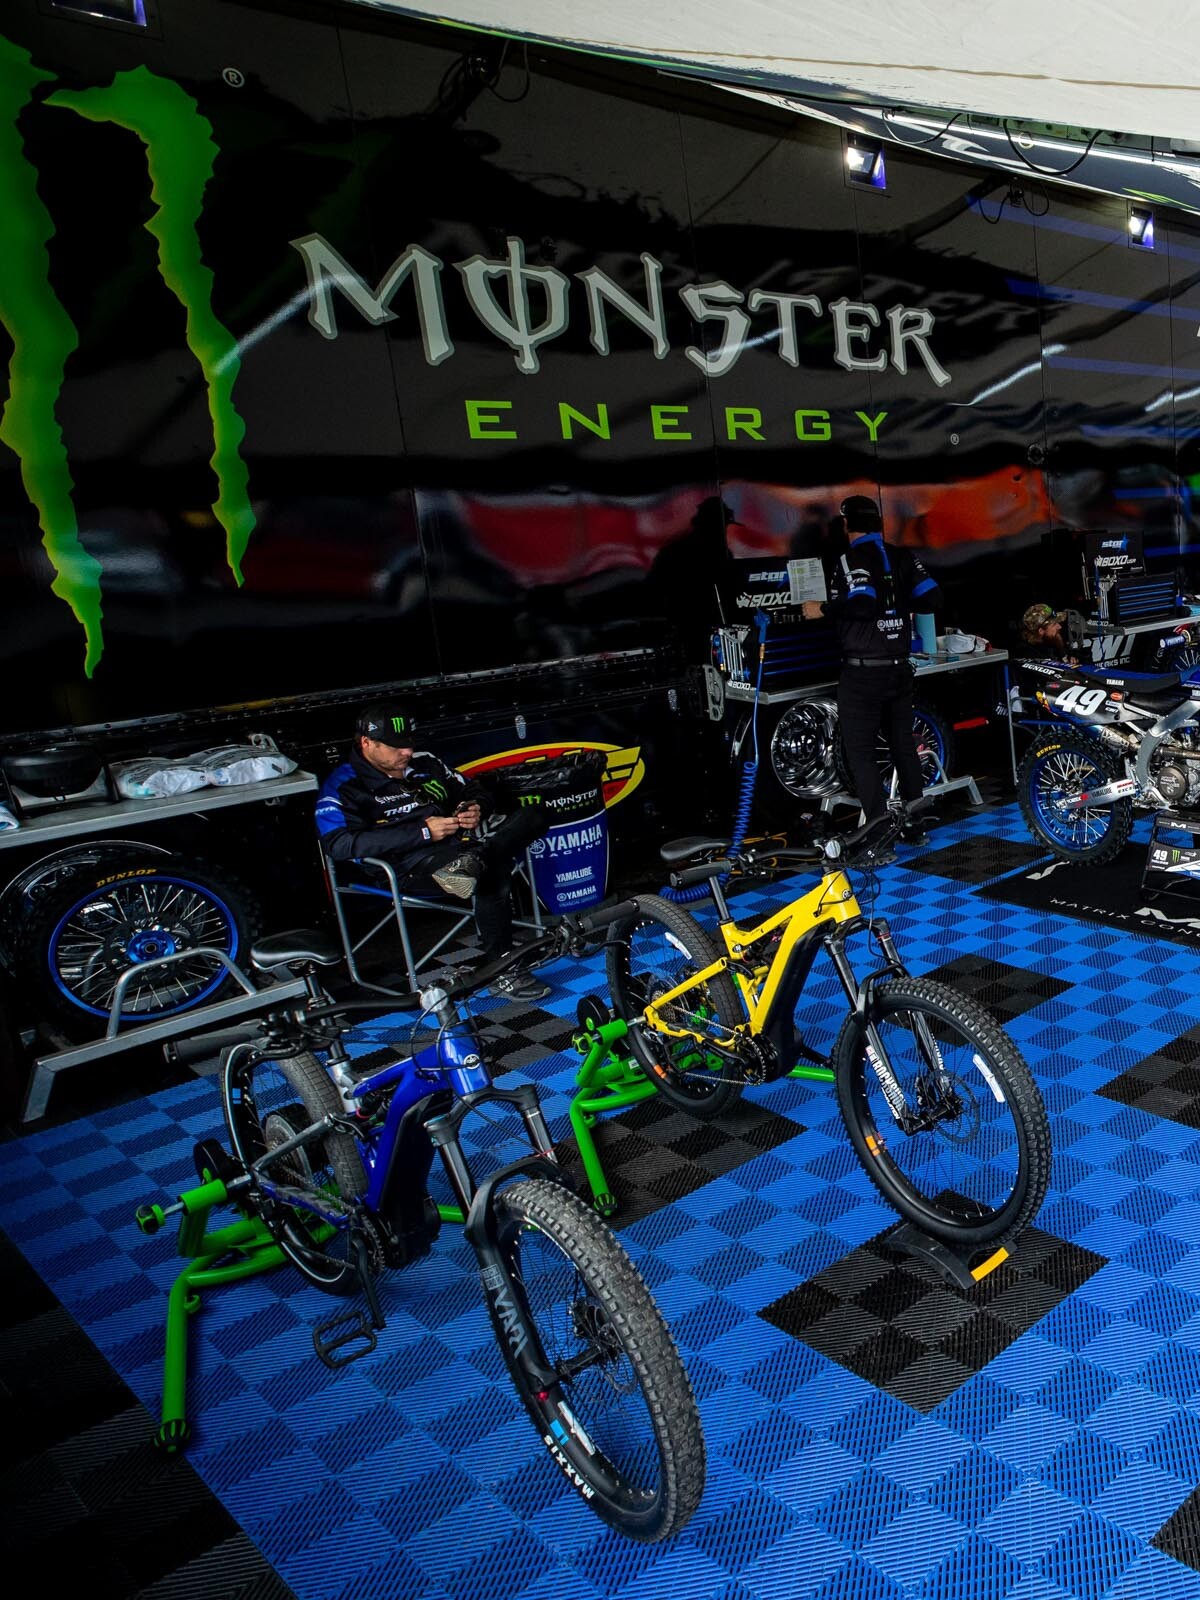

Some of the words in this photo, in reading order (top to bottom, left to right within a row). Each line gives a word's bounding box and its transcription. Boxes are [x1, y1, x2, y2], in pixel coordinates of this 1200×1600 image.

[465, 400, 888, 443] ENERGY
[1022, 663, 1055, 676] DUNLOP
[1055, 685, 1107, 715] 49
[1035, 744, 1061, 758] DUNLOP
[545, 788, 598, 808] MONSTER
[545, 824, 603, 851] YAMAHA
[535, 840, 601, 859] RACING
[1153, 849, 1168, 860] 49
[96, 868, 157, 888] DUNLOP
[556, 866, 592, 883] YAMALUBE
[566, 885, 596, 900] YAMAHA
[1050, 897, 1130, 920] MATRIX
[544, 1435, 595, 1500] MAXXIS
